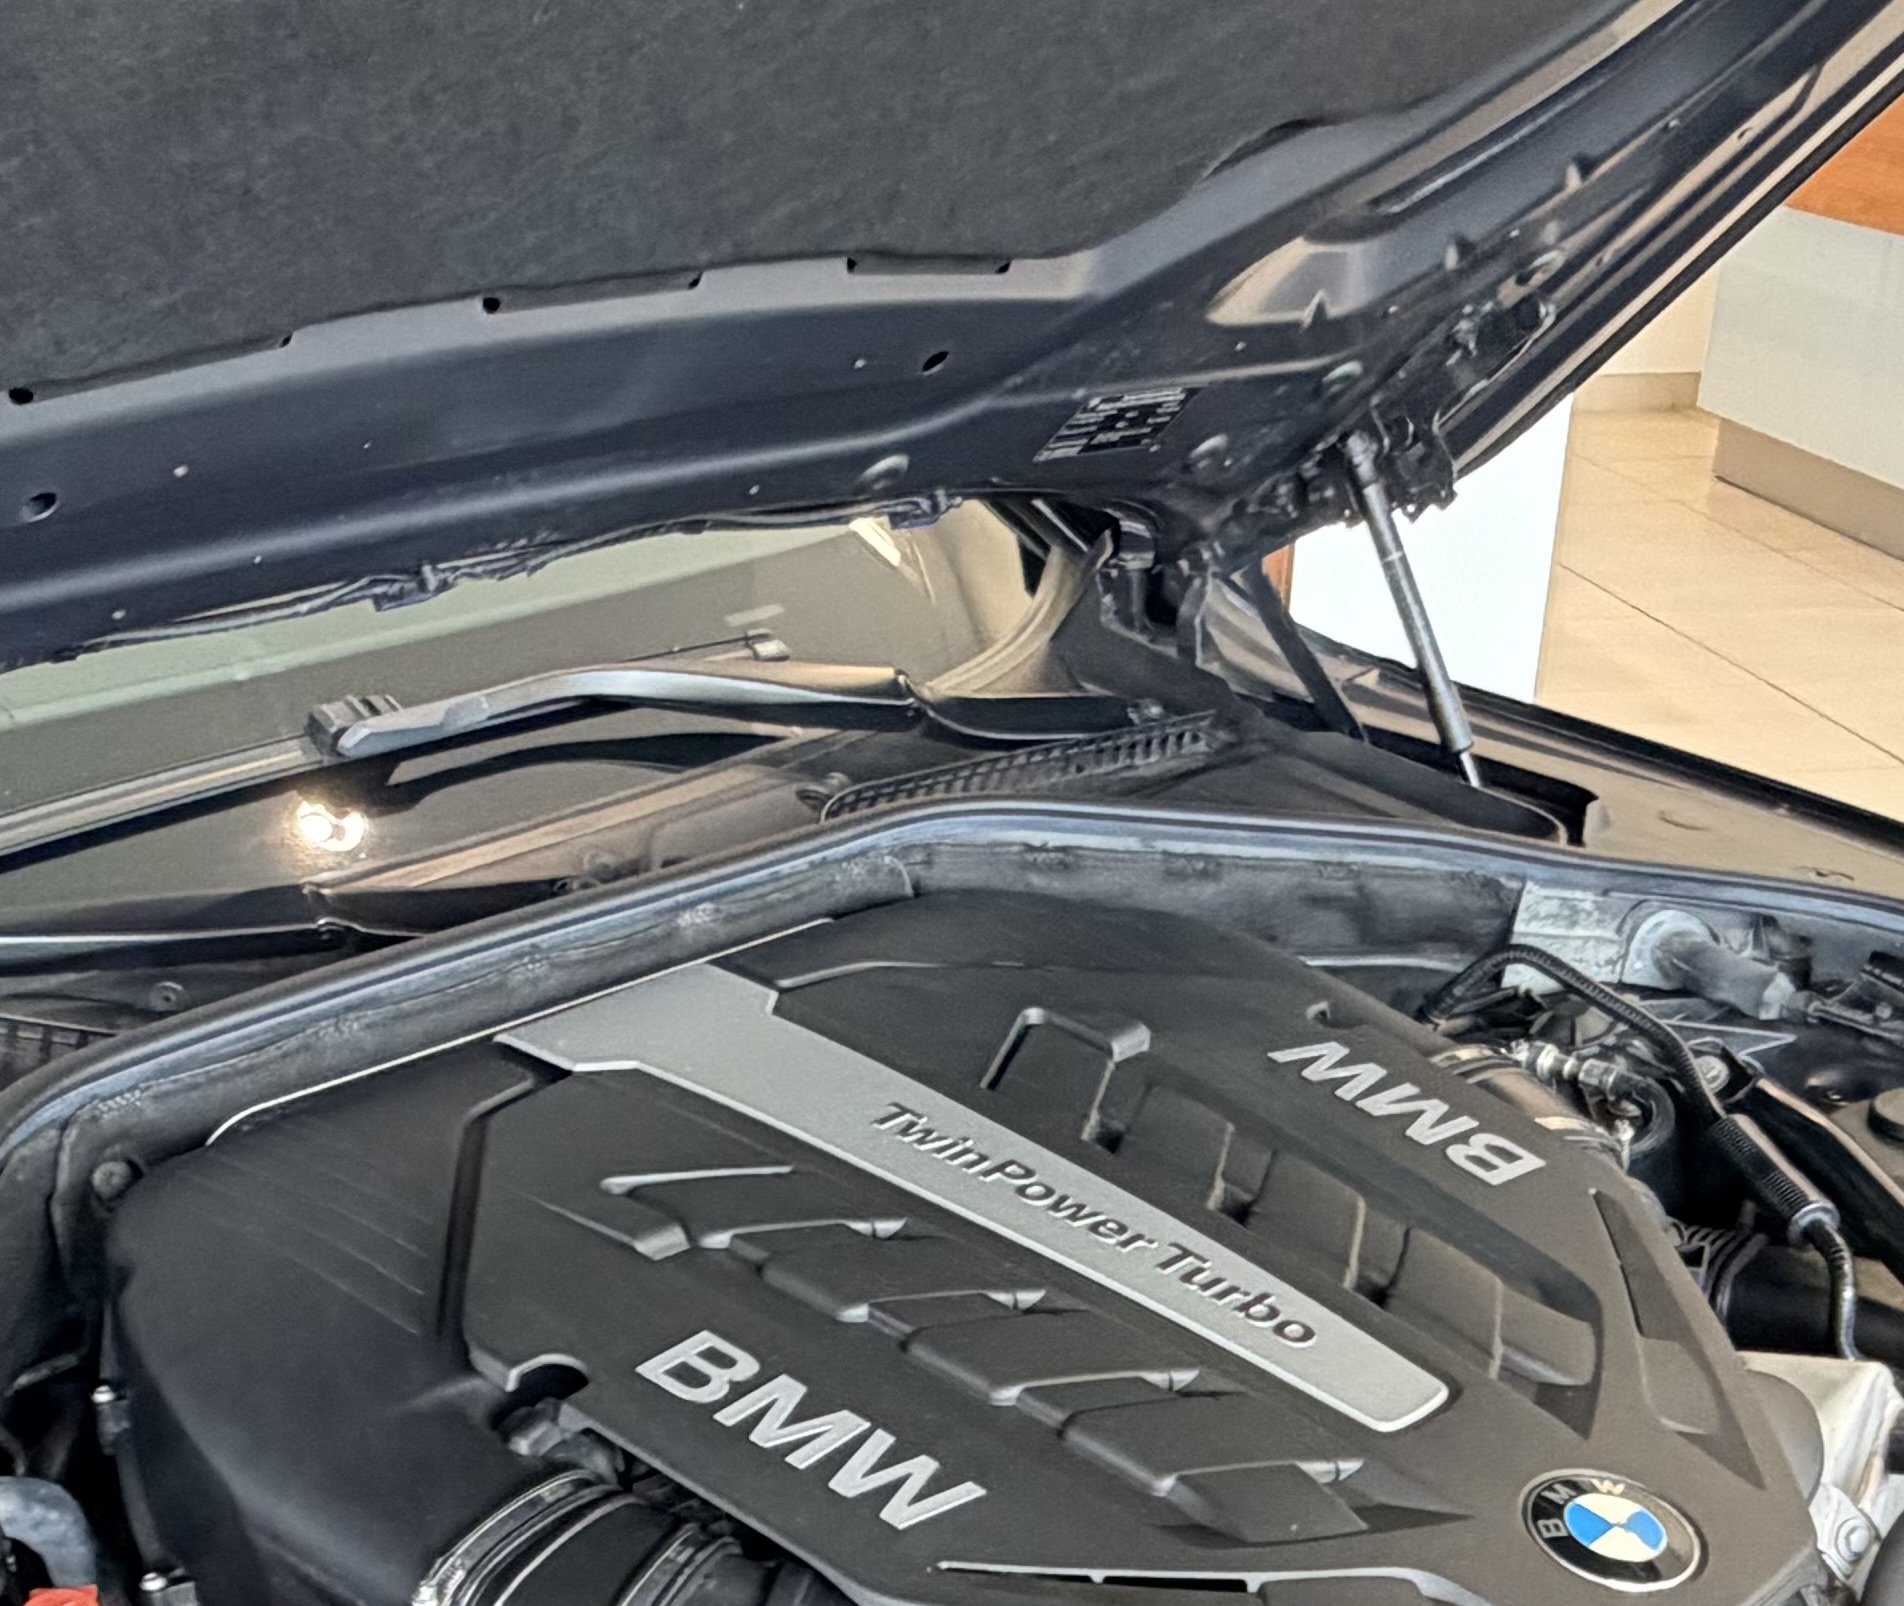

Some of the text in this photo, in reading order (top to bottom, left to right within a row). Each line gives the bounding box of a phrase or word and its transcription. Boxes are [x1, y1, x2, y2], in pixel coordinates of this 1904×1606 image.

[1267, 1041, 1547, 1186] BMW
[871, 1101, 1317, 1348] TwinPower Turbo
[635, 1329, 988, 1530] BMW
[1536, 1478, 1626, 1539] BMW
